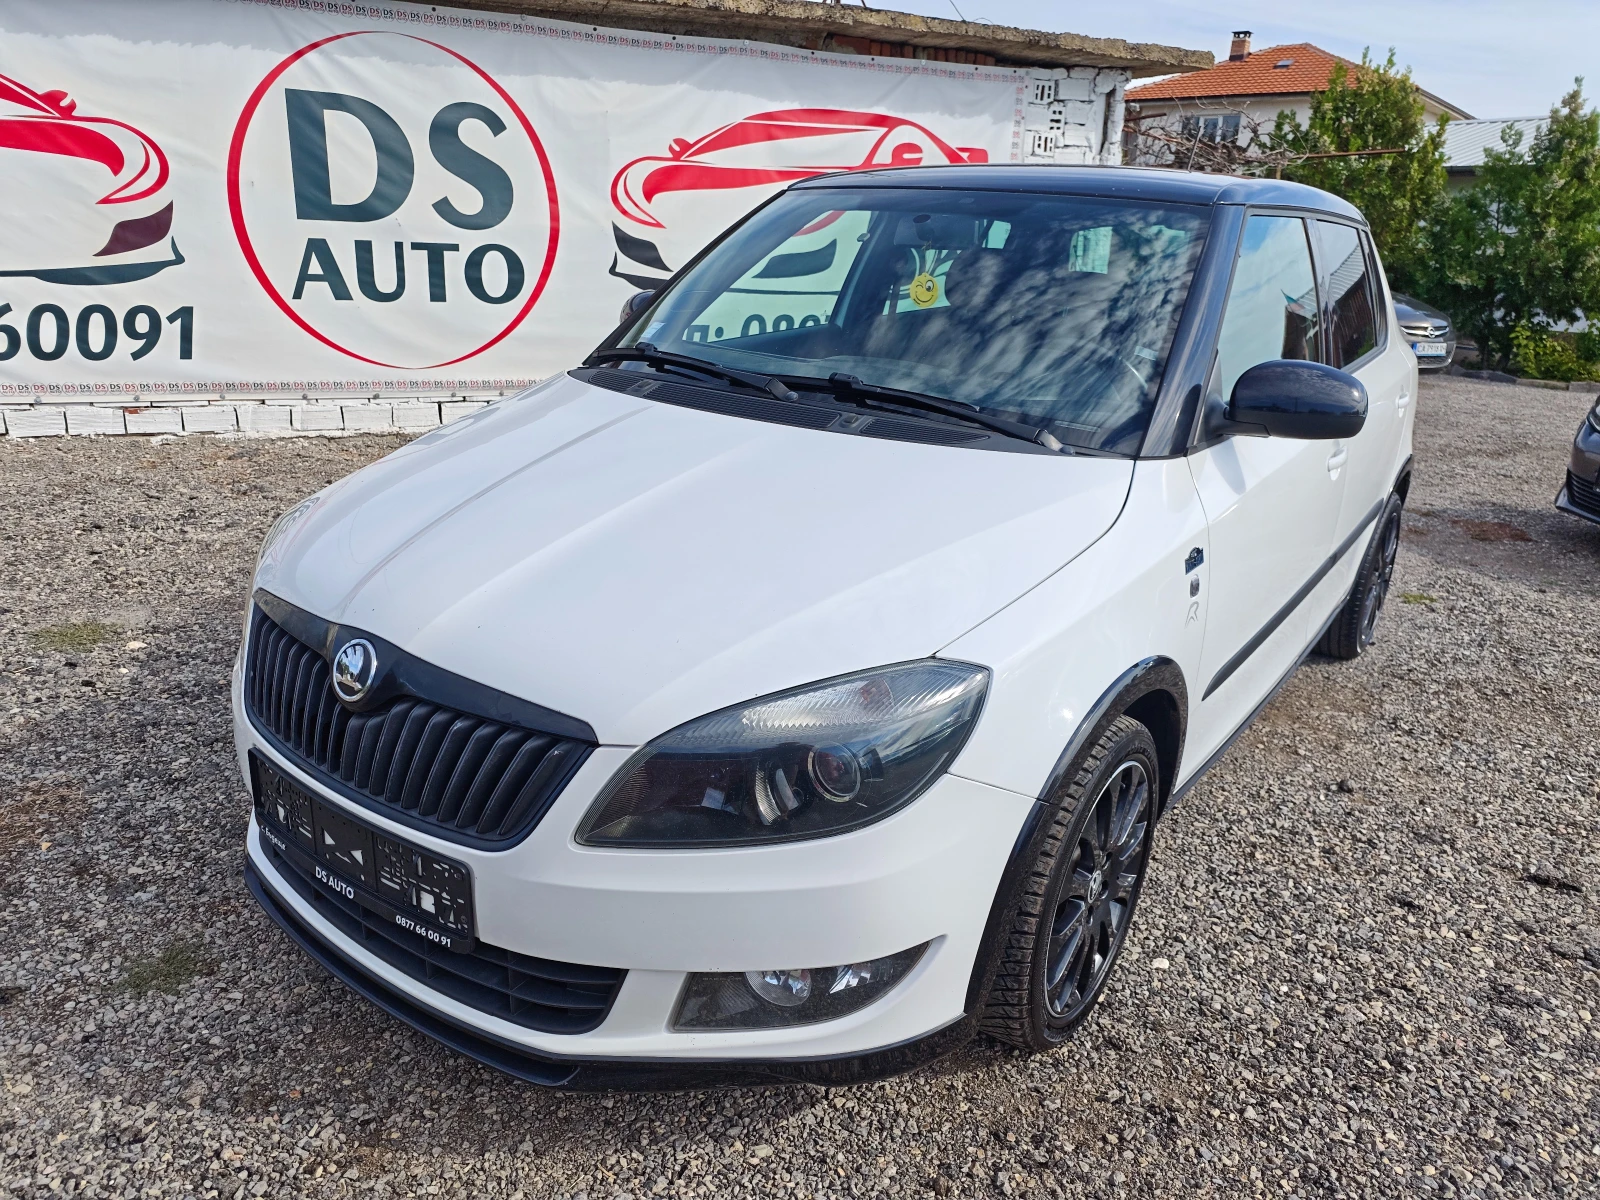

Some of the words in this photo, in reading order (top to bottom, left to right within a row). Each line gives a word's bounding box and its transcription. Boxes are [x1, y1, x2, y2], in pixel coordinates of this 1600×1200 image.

[285, 88, 514, 231] DS
[291, 238, 525, 305] AUTO
[316, 866, 327, 882] DS
[328, 876, 354, 899] AUTO
[396, 915, 414, 930] 0877
[416, 925, 426, 936] 66
[428, 930, 439, 942] 00
[441, 936, 450, 947] 91
